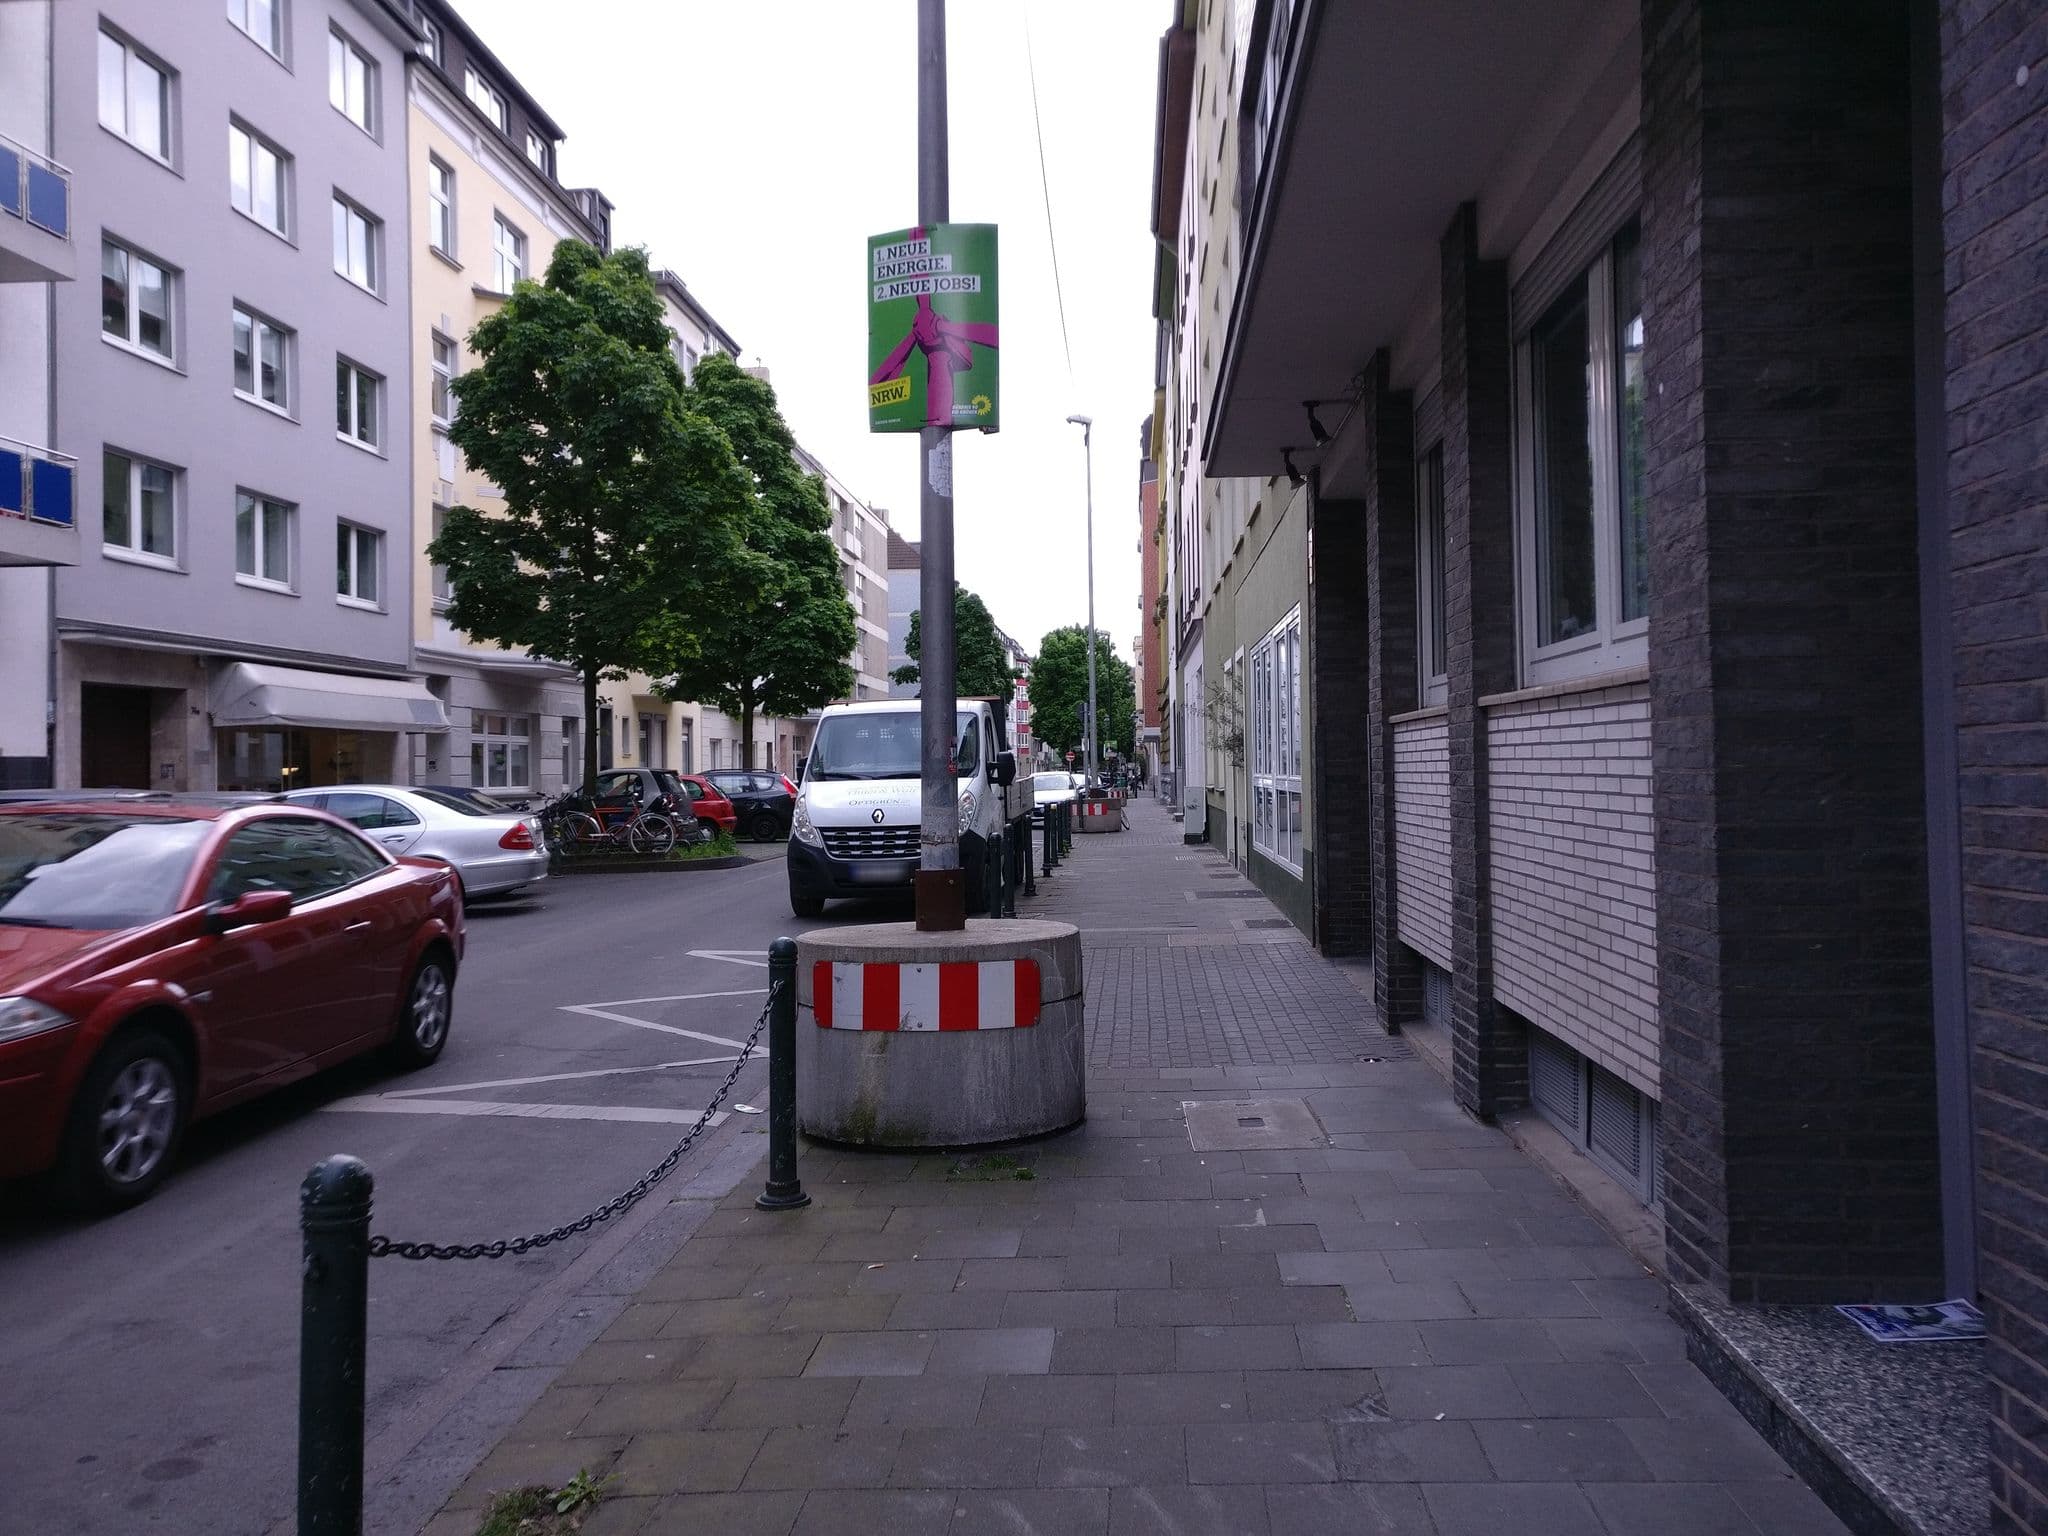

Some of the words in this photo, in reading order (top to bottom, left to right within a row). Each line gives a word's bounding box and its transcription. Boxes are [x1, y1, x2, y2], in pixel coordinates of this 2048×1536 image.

[877, 249, 885, 262] 1.
[887, 241, 927, 260] NEUE
[877, 257, 948, 279] ENERGIE.
[877, 286, 888, 300] 2.
[889, 279, 930, 297] NEUE
[934, 277, 976, 293] JOBS!
[871, 385, 907, 405] NRW.
